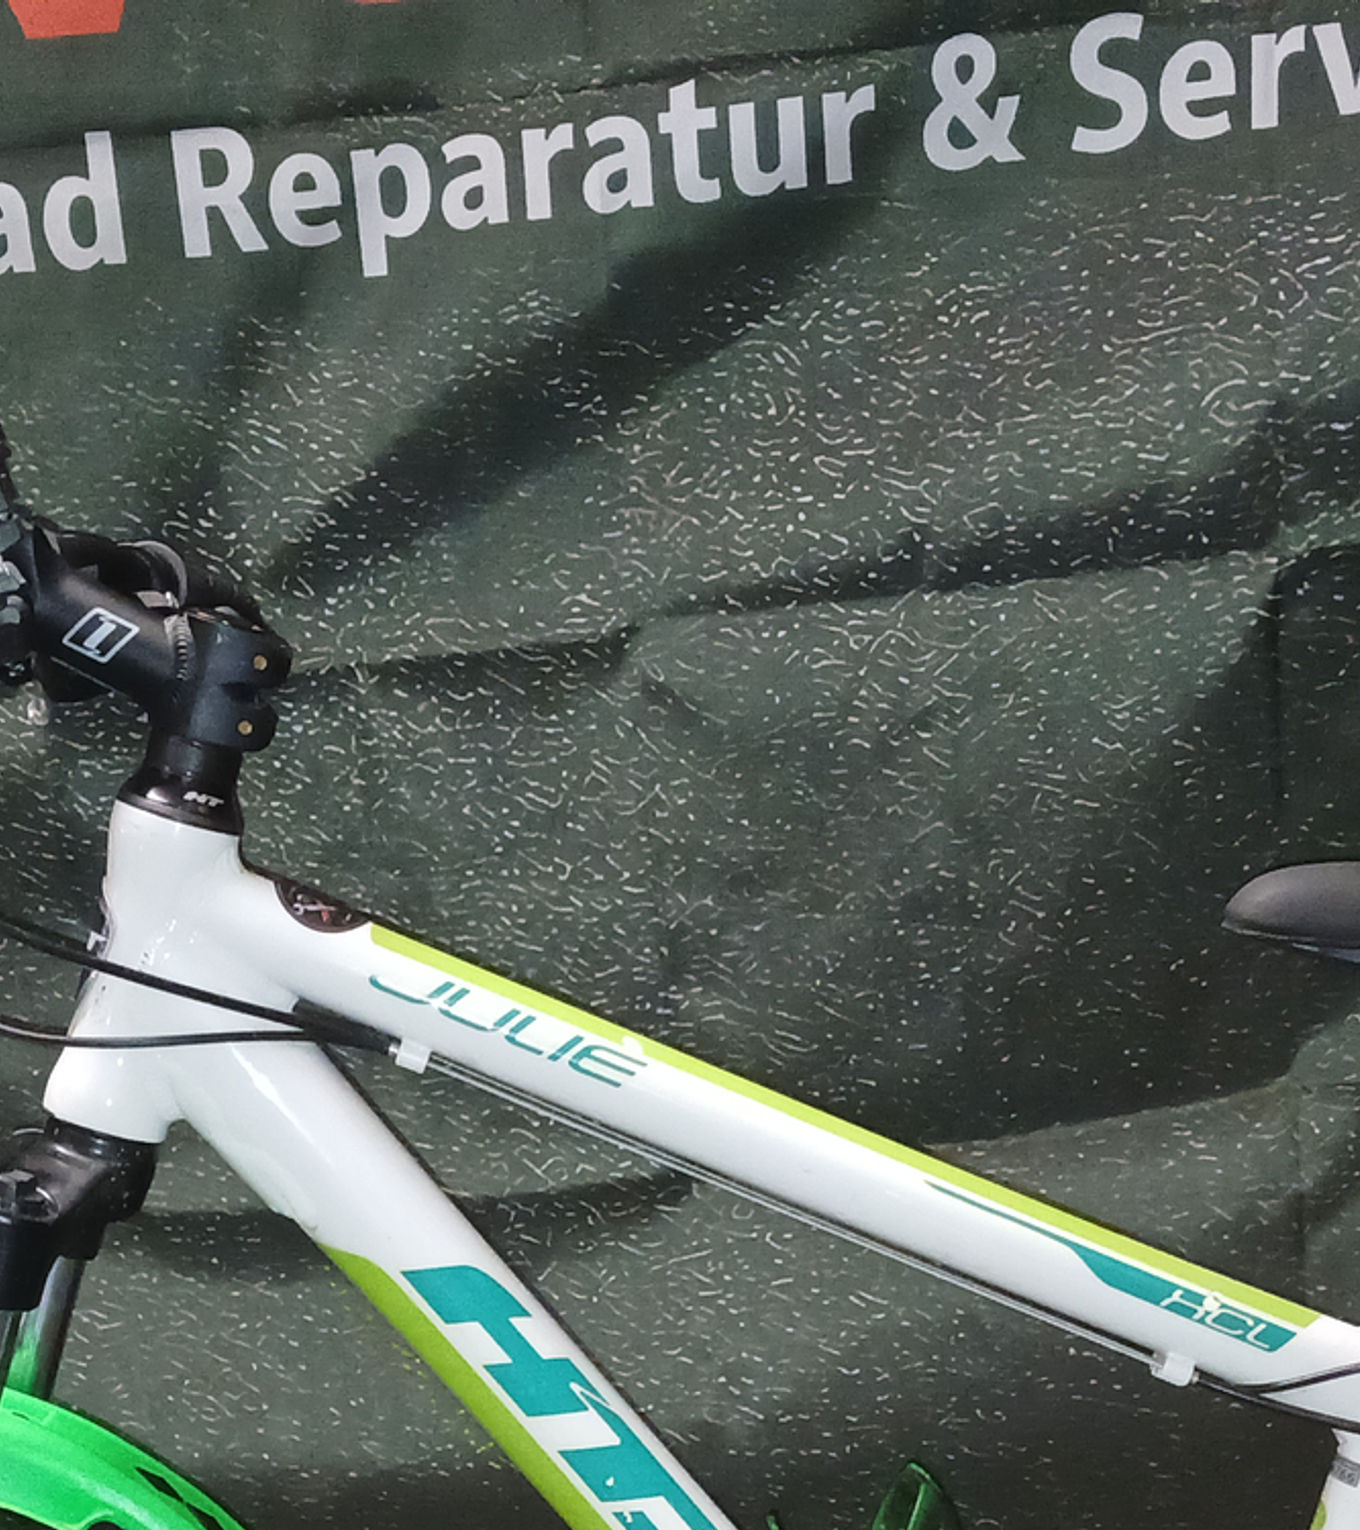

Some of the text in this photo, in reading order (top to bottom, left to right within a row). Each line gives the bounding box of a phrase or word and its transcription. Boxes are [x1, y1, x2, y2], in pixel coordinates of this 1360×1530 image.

[170, 74, 878, 280] Reparatur
[921, 31, 1026, 173] &
[369, 974, 648, 1087] JULIE
